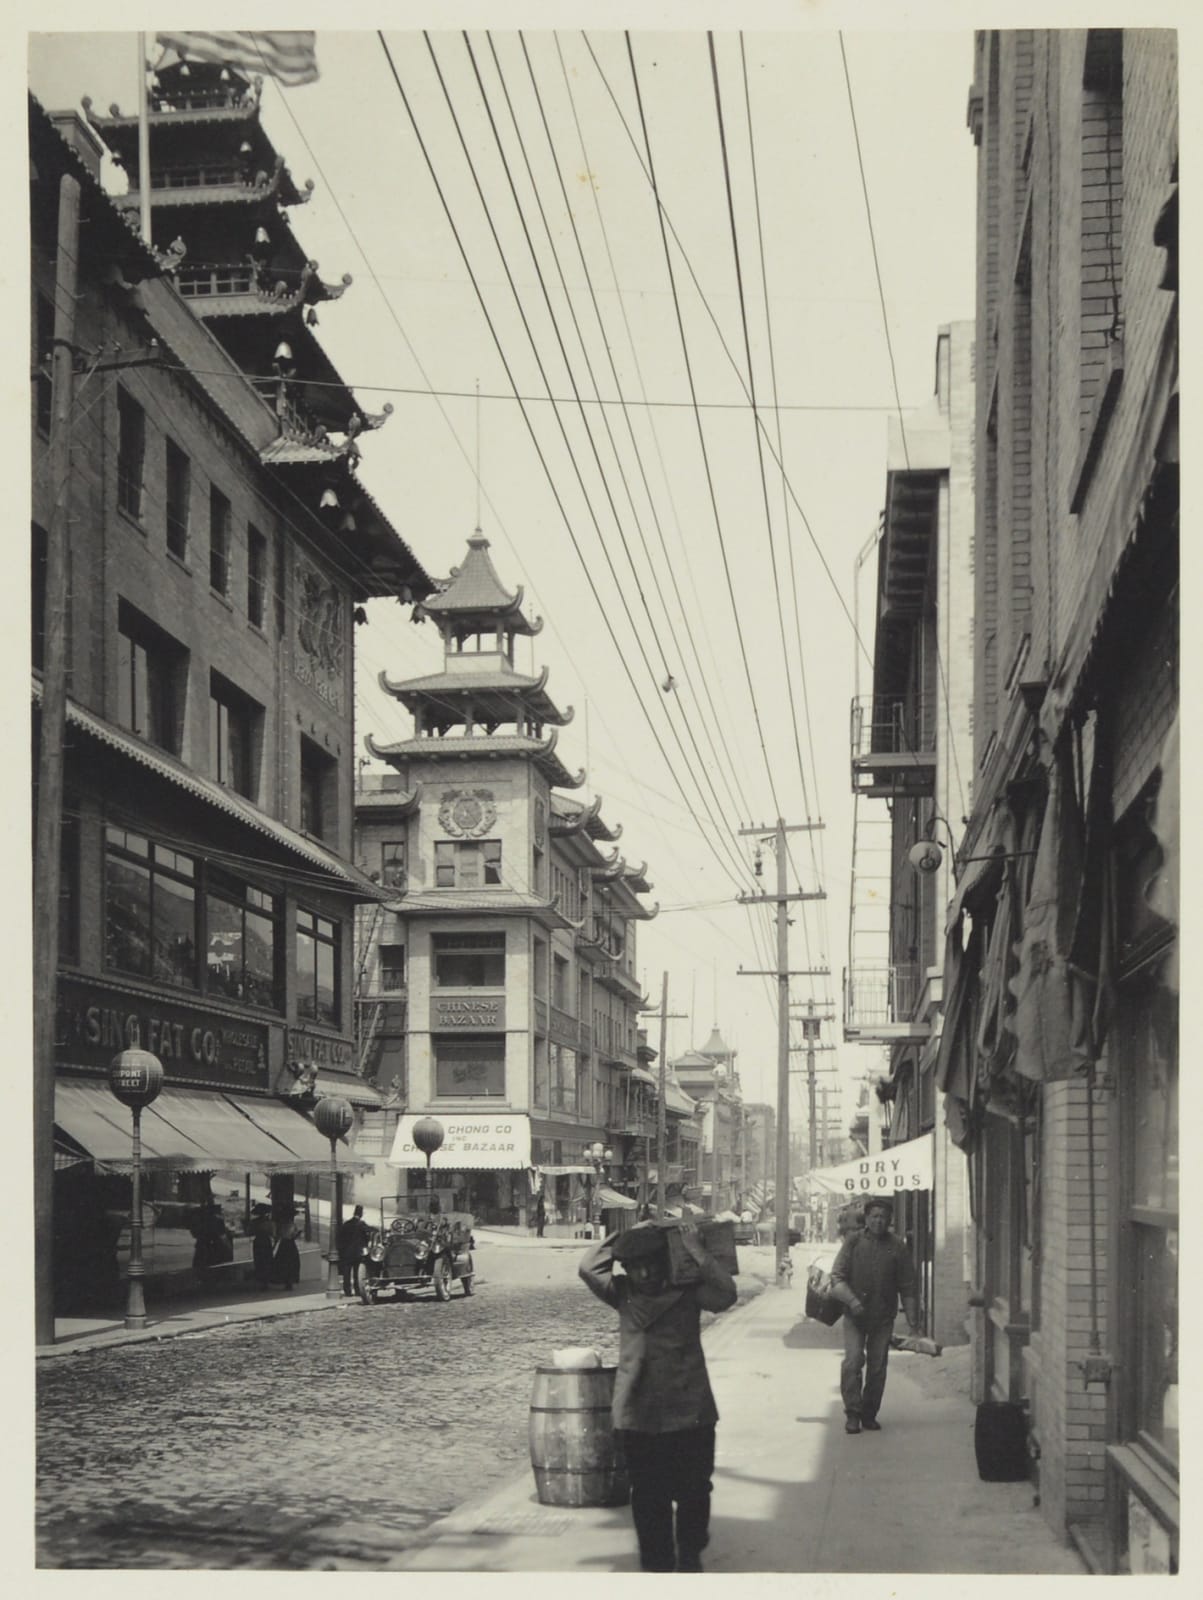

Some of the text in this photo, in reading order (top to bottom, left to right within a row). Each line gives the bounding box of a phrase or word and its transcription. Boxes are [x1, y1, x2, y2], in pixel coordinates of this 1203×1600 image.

[435, 1001, 498, 1012] CHINESE
[438, 1014, 496, 1026] BAZAAR
[147, 1018, 184, 1057] FAT
[312, 1038, 331, 1062] FAT
[448, 1124, 511, 1134] CHONG CO
[403, 1142, 514, 1153] CHSE BAZAAR
[860, 1160, 900, 1175] DRY
[844, 1175, 920, 1190] GOODS
